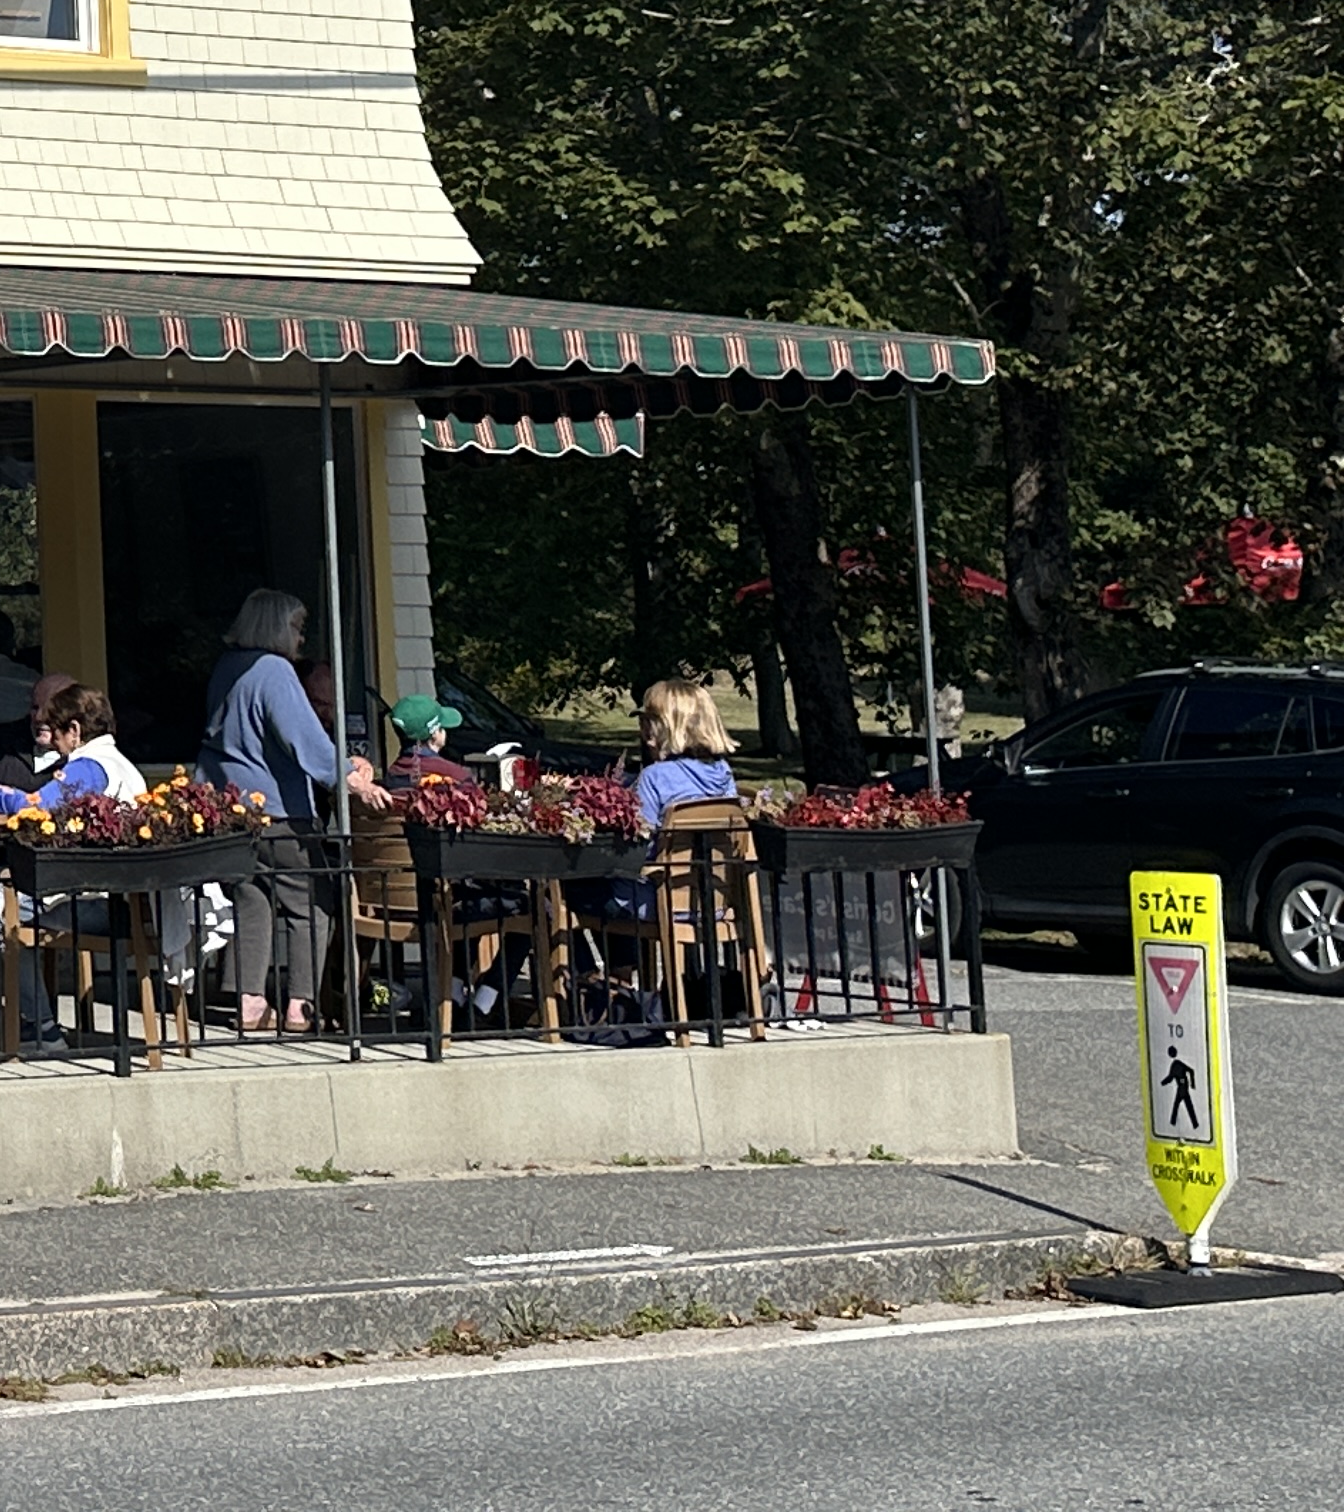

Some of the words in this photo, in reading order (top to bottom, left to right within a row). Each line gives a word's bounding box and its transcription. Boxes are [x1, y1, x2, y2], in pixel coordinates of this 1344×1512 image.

[1138, 891, 1207, 914] STATE
[1149, 914, 1194, 935] LAW
[1167, 1023, 1184, 1038] TO
